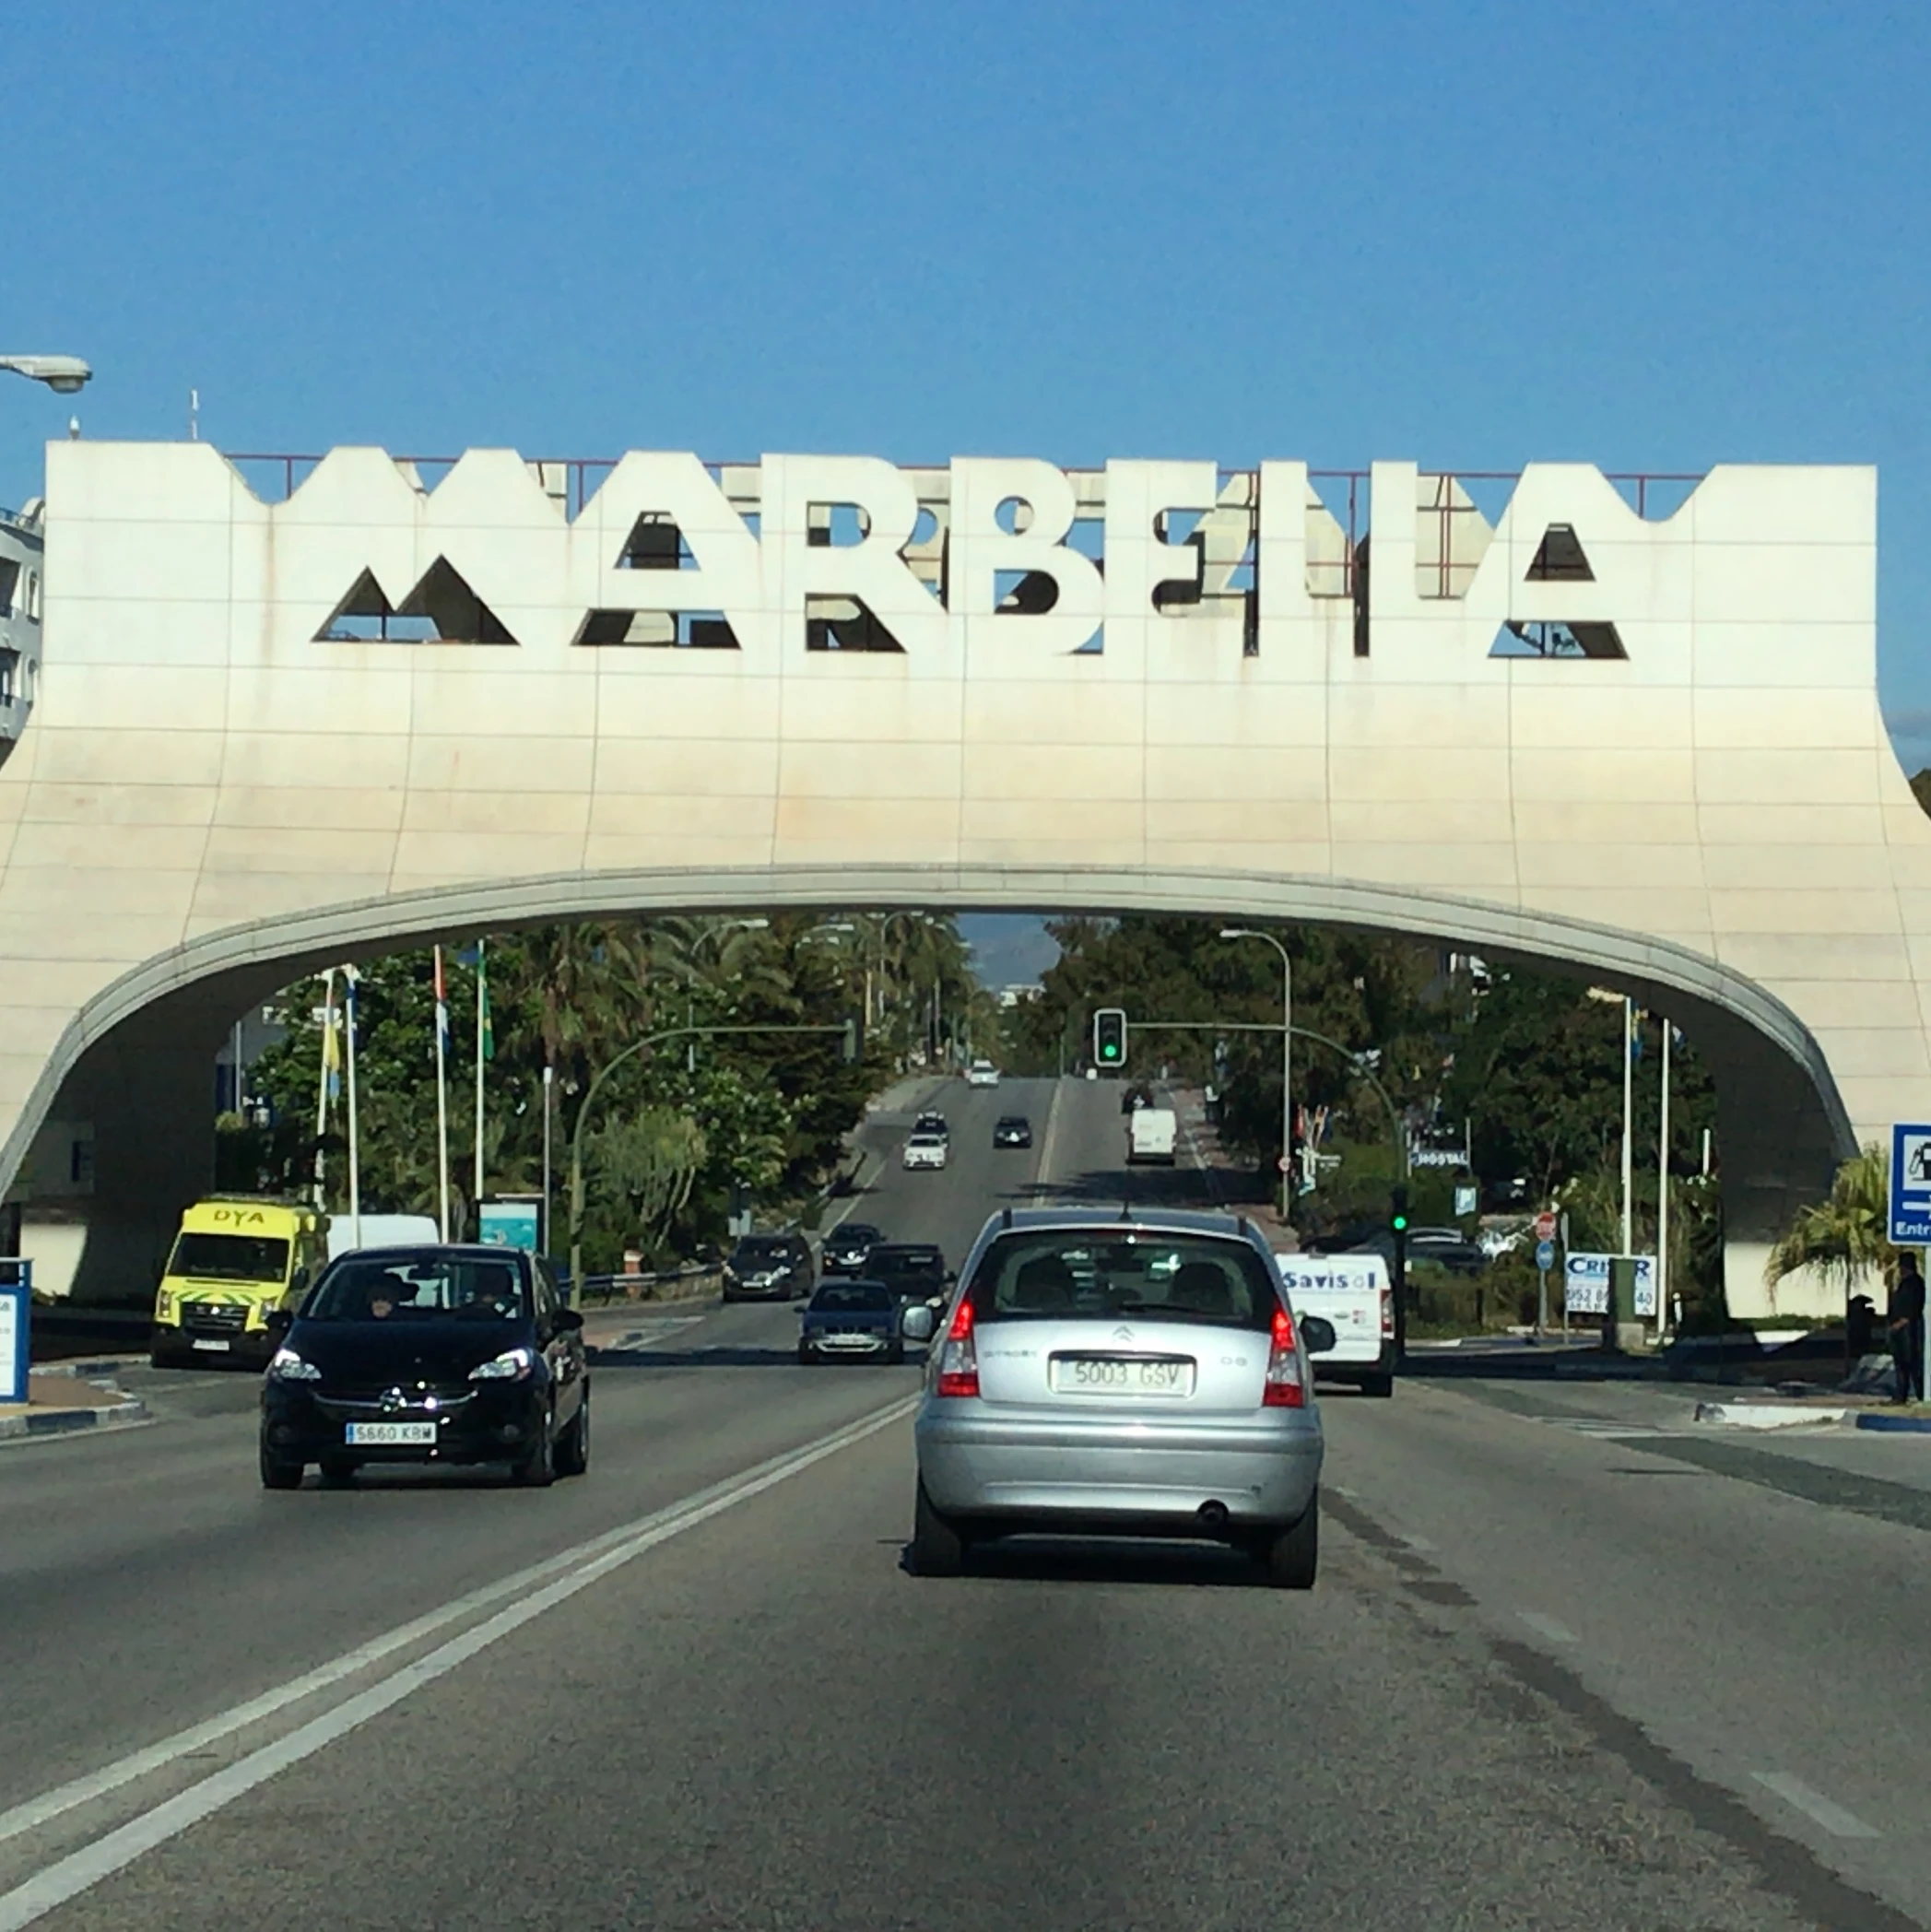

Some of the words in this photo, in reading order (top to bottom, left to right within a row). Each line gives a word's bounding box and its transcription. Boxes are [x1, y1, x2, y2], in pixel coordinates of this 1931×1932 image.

[253, 446, 1679, 658] MARBELLA
[213, 1209, 265, 1228] DYA
[1282, 1271, 1376, 1290] Savisol
[1075, 1362, 1128, 1384] 5003
[1139, 1362, 1180, 1385] GSV
